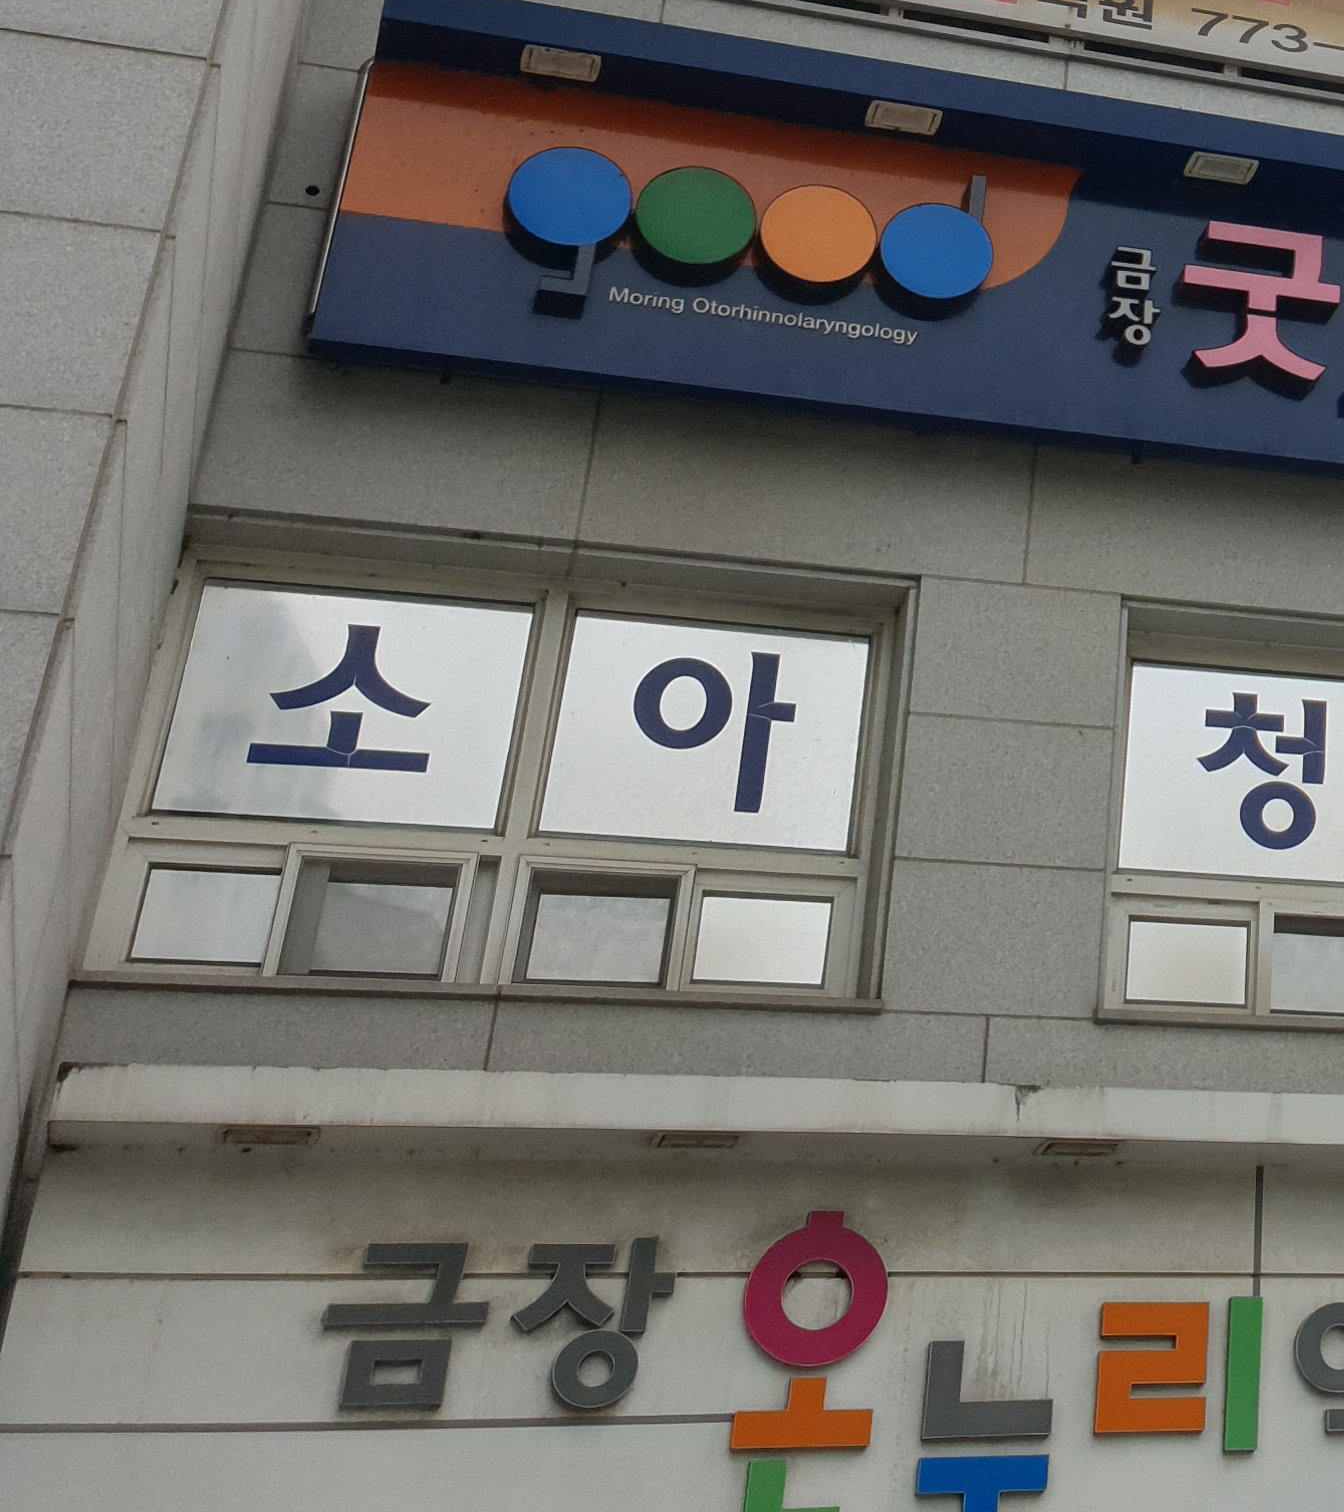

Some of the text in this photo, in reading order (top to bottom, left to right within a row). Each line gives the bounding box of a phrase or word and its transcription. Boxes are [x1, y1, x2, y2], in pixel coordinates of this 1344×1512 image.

[608, 285, 686, 315] Moring
[1107, 245, 1162, 348] 금장
[321, 1235, 677, 1412] 금장
